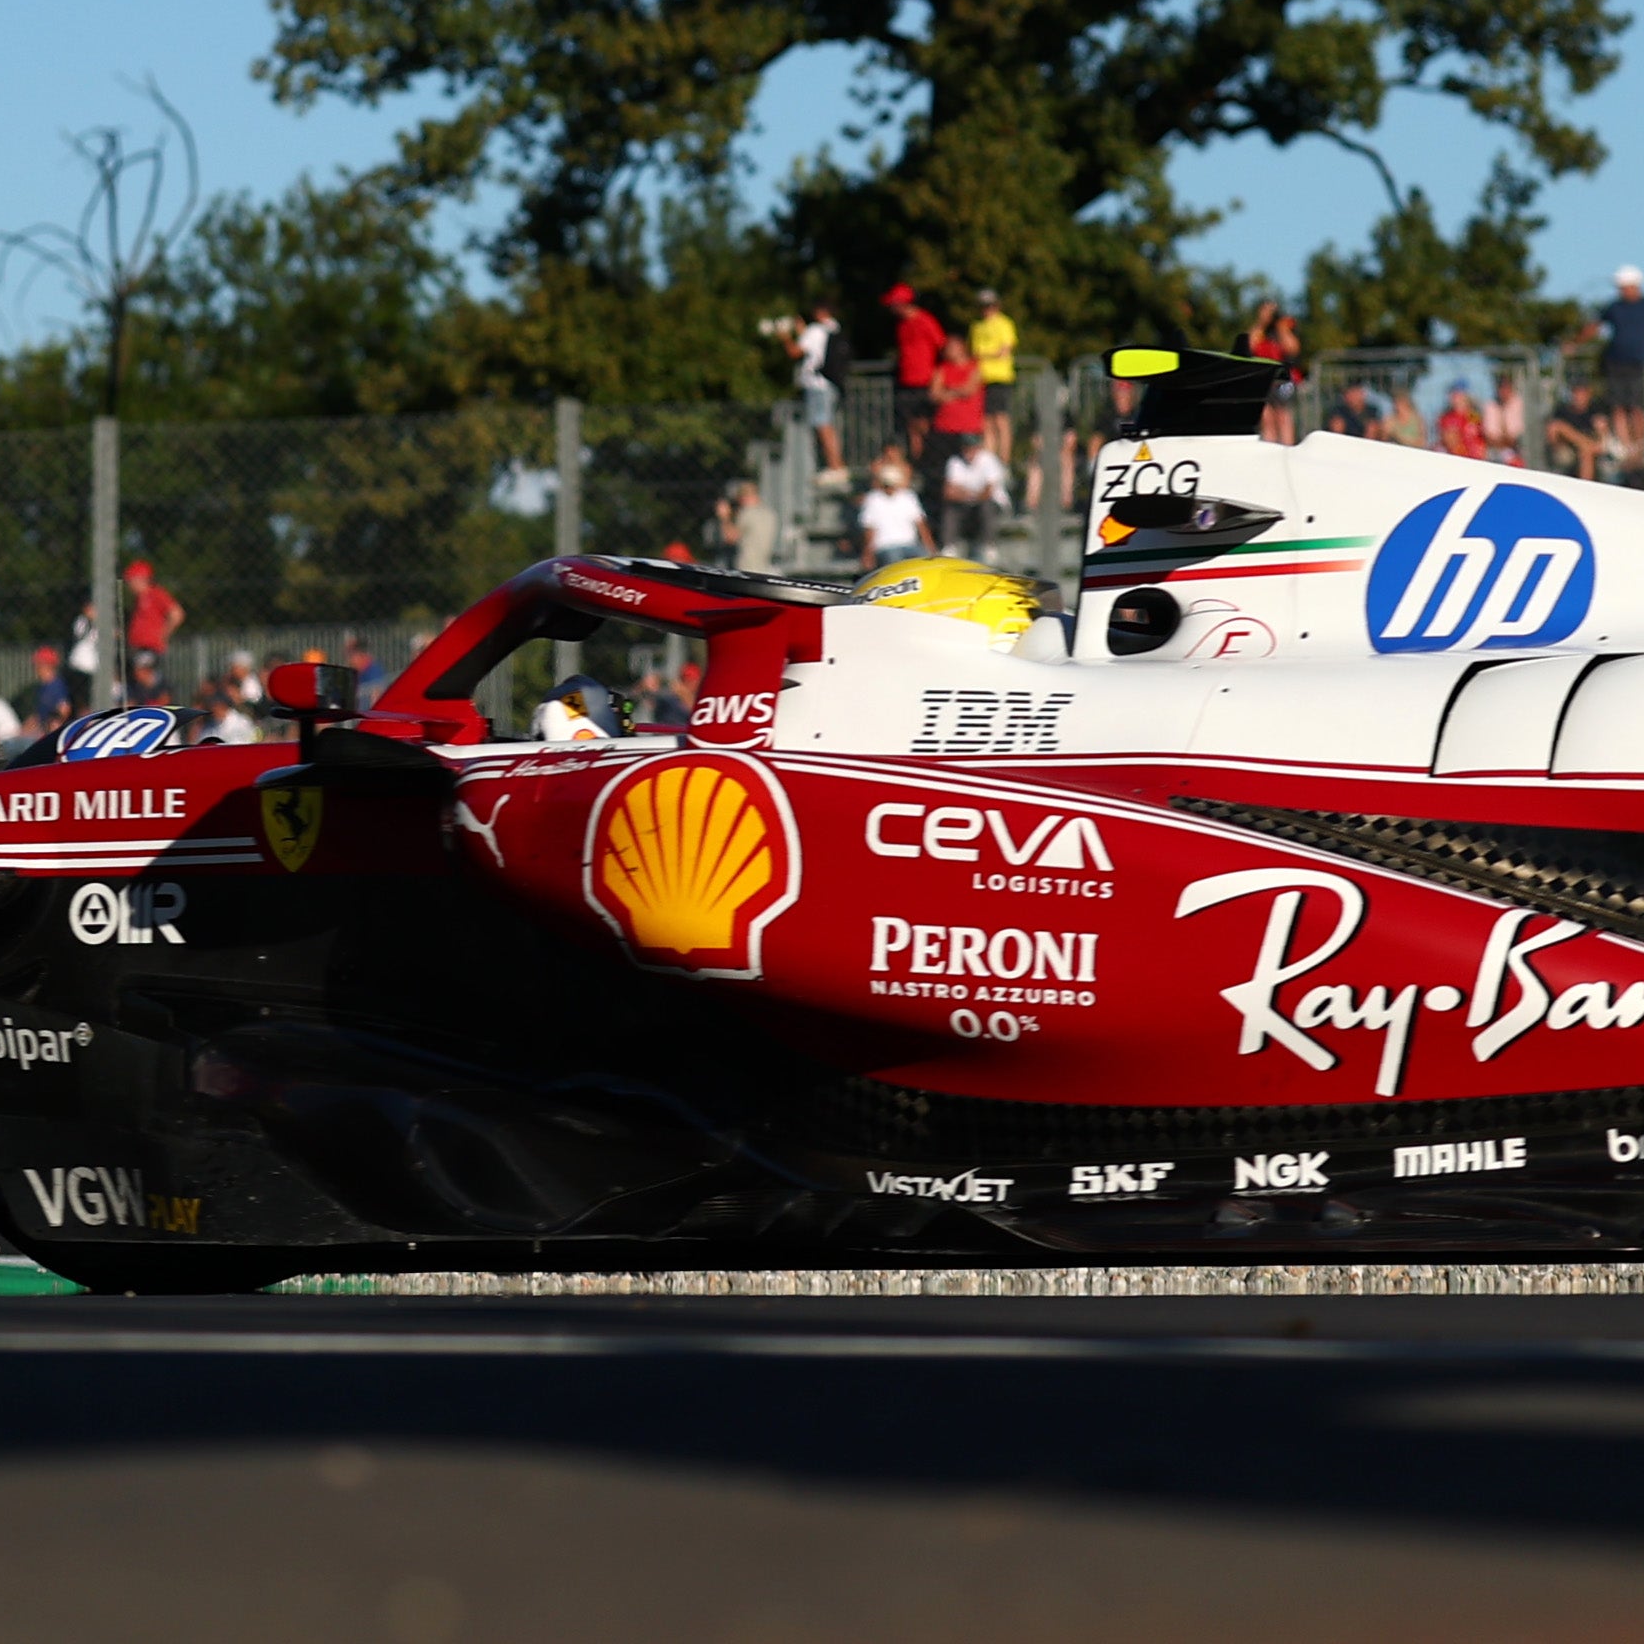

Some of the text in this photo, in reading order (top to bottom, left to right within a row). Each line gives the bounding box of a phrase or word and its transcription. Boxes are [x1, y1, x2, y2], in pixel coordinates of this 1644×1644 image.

[1100, 460, 1201, 503] ZCG
[1380, 484, 1583, 654] hp
[691, 691, 776, 727] aws
[910, 689, 1075, 753] IBM
[74, 788, 187, 821] MILLE
[972, 872, 1115, 899] LOGISTICS
[869, 916, 1099, 982] PERONI
[870, 980, 1097, 1007] NASTRO AZZURRO
[949, 1008, 1041, 1042] 0.0%
[1234, 1151, 1331, 1190] NGK
[1393, 1136, 1527, 1178] MAHLE
[23, 1166, 146, 1227] VGW
[1069, 1162, 1175, 1196] SKF
